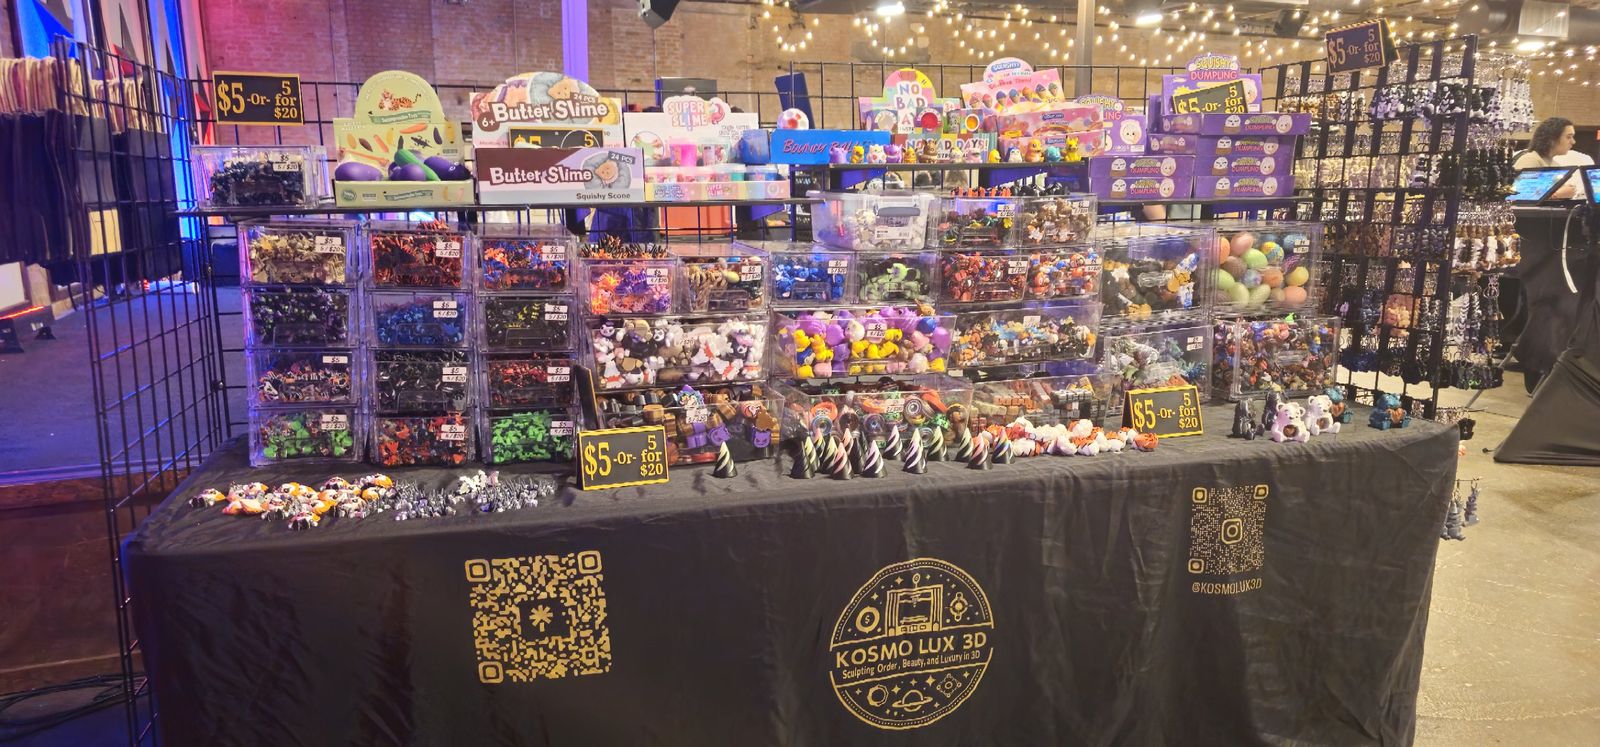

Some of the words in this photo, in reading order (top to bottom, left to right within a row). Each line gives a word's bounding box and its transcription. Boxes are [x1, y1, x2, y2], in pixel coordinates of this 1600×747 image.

[1368, 29, 1375, 42] 5
[1328, 38, 1346, 68] $5
[1364, 41, 1379, 52] for
[1364, 53, 1380, 64] $20
[1190, 71, 1237, 80] DUMPLING
[280, 80, 292, 97] 5
[899, 84, 920, 95] NO
[1228, 85, 1237, 98] 5
[217, 80, 245, 116] $5
[246, 94, 270, 106] -Or-
[274, 94, 297, 107] for
[896, 96, 926, 110] BAD
[1224, 96, 1242, 106] for
[274, 106, 298, 120] $20
[491, 102, 553, 122] Butter
[556, 100, 608, 120] Slime
[668, 101, 705, 113] SUPER
[482, 117, 495, 127] 6+
[672, 112, 708, 127] SLIME
[784, 139, 826, 154] Bouncy
[611, 152, 620, 160] 24
[622, 155, 634, 164] PCS
[490, 167, 542, 185] Butter
[548, 165, 593, 182] Slime
[576, 192, 606, 200] Squishy
[608, 192, 631, 200] Scone
[1184, 392, 1192, 406] 5
[1134, 398, 1156, 432] $5
[1156, 408, 1176, 418] -Or-
[1178, 405, 1196, 417] for
[1178, 417, 1198, 430] $20
[648, 435, 656, 450] 5
[584, 440, 612, 481] $5
[614, 452, 636, 465] -Or-
[641, 449, 663, 462] for
[640, 463, 663, 478] $20
[1192, 578, 1262, 595] @KOSMOLUX3D
[836, 640, 913, 668] KOSMO
[920, 636, 955, 654] LUX
[963, 632, 987, 650] 3D
[842, 663, 875, 680] Sculpting
[902, 658, 926, 668] Beauty,
[927, 656, 940, 665] and
[940, 654, 963, 666] Luxury
[970, 651, 981, 660] 3D
